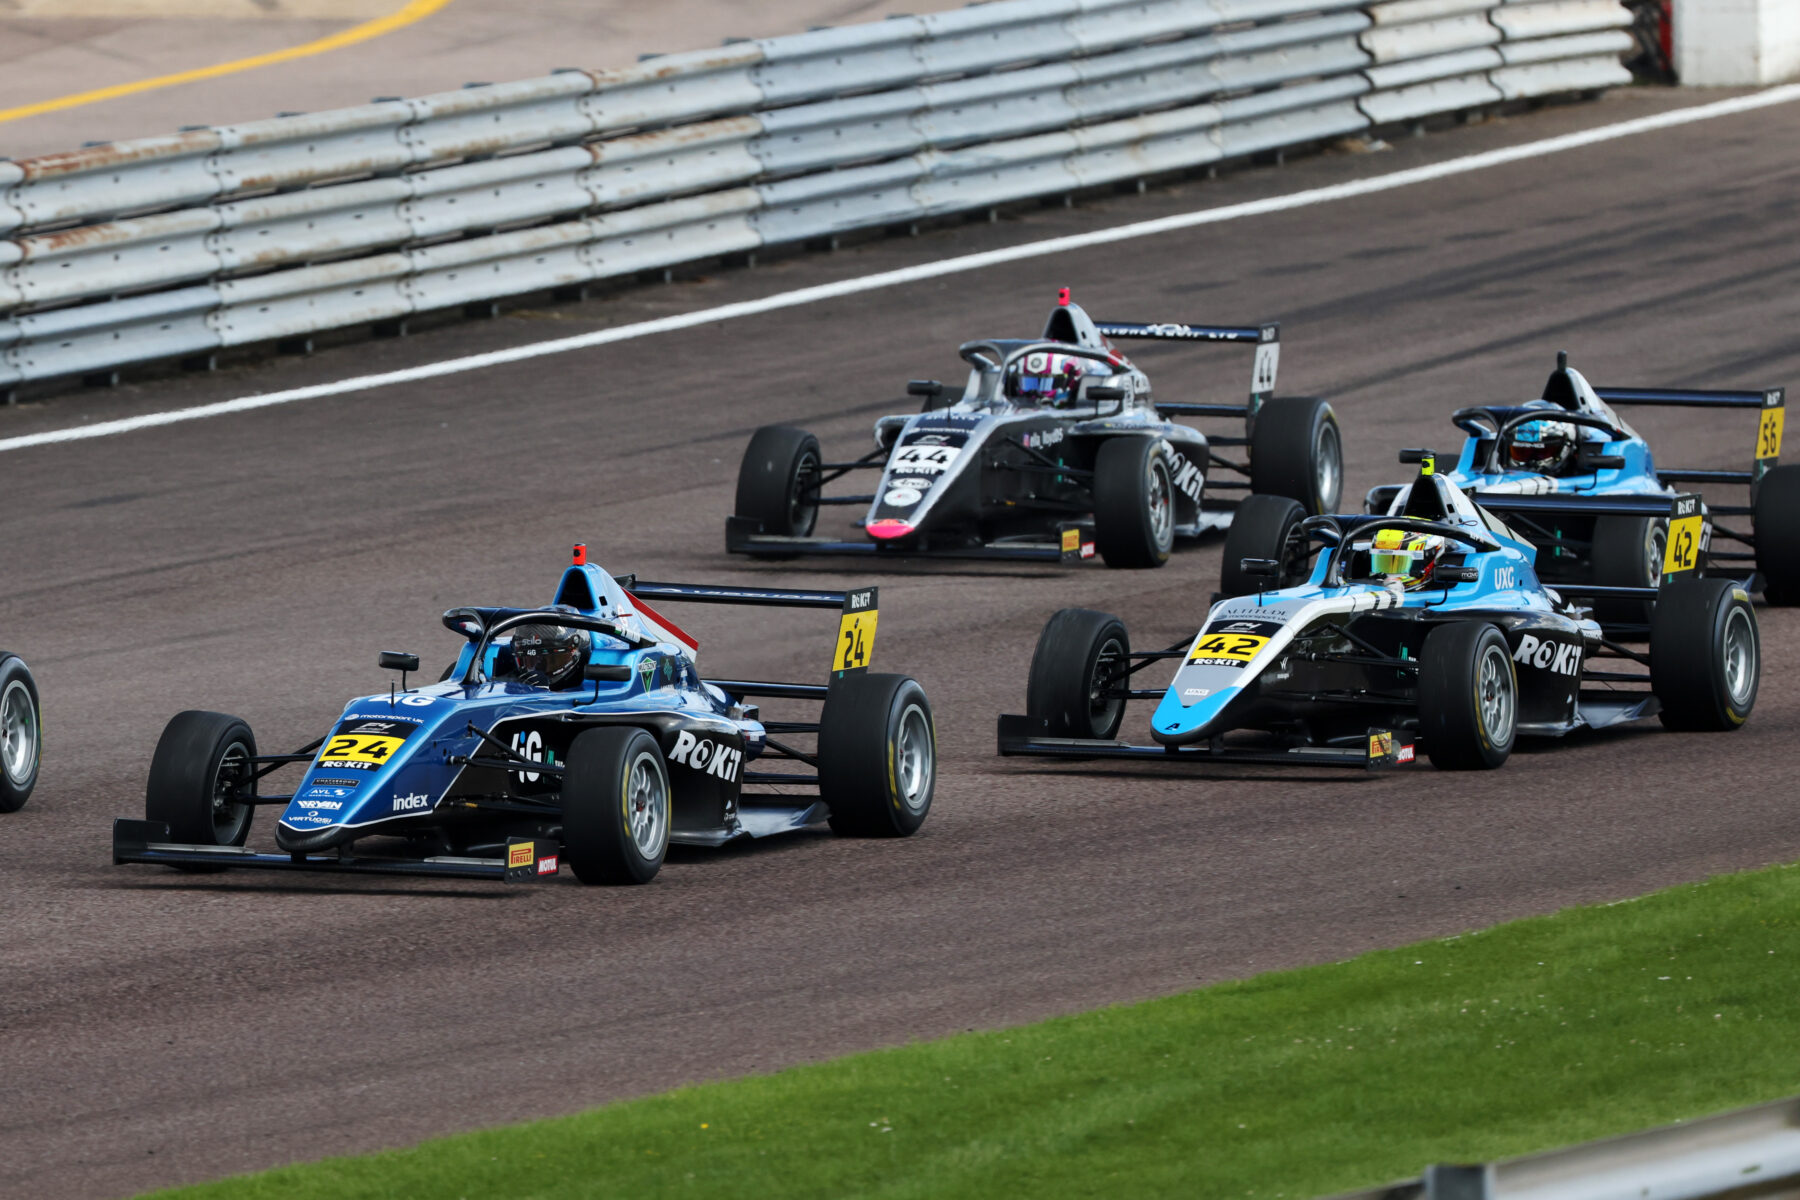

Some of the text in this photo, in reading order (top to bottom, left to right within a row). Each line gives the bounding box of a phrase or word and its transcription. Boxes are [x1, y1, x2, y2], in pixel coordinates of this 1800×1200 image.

[1763, 421, 1777, 456] 56
[898, 449, 948, 463] 44
[1673, 531, 1693, 568] 42
[1494, 566, 1515, 590] UXG
[843, 629, 865, 668] 24
[1198, 637, 1260, 656] 42
[324, 739, 389, 759] 24
[392, 793, 428, 811] index
[510, 848, 532, 865] PIRELLI
[538, 857, 557, 874] MOTUL
